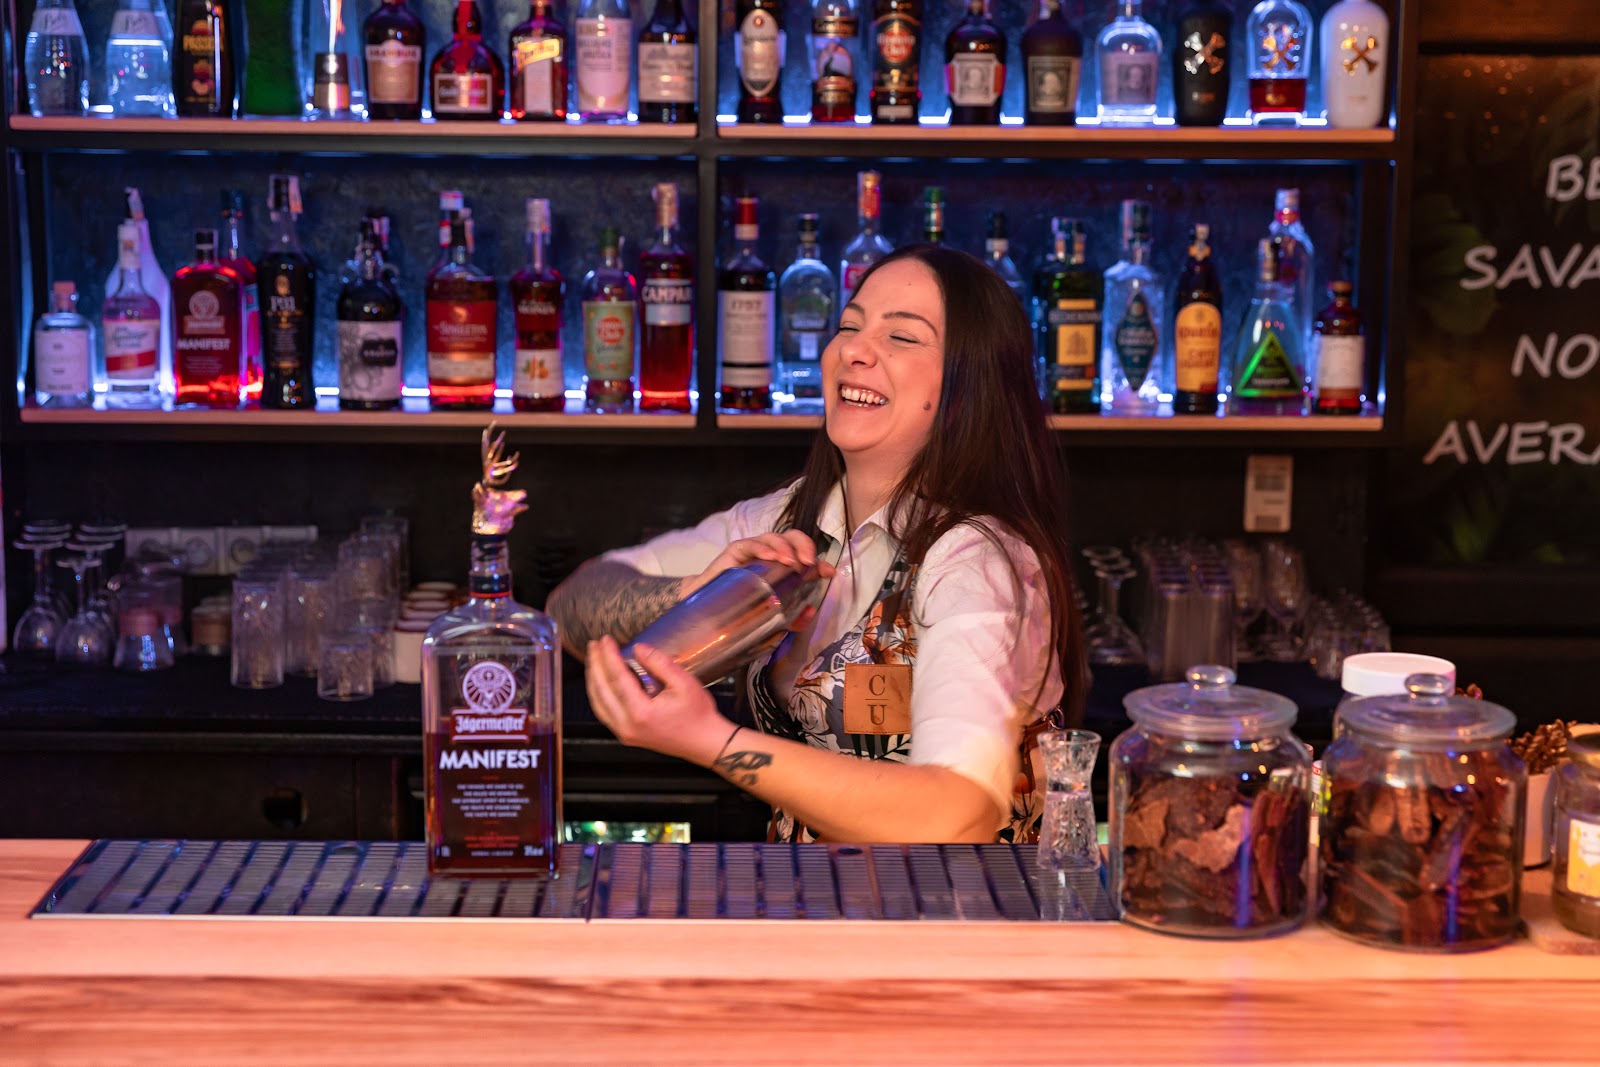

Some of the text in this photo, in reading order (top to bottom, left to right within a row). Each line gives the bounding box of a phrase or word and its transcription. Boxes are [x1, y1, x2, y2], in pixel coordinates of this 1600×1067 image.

[177, 337, 231, 351] MANIFEST
[1422, 418, 1600, 466] AVER
[869, 675, 886, 696] C
[455, 716, 525, 733] Jägermeister
[867, 704, 887, 725] U
[439, 750, 541, 769] MANIFEST
